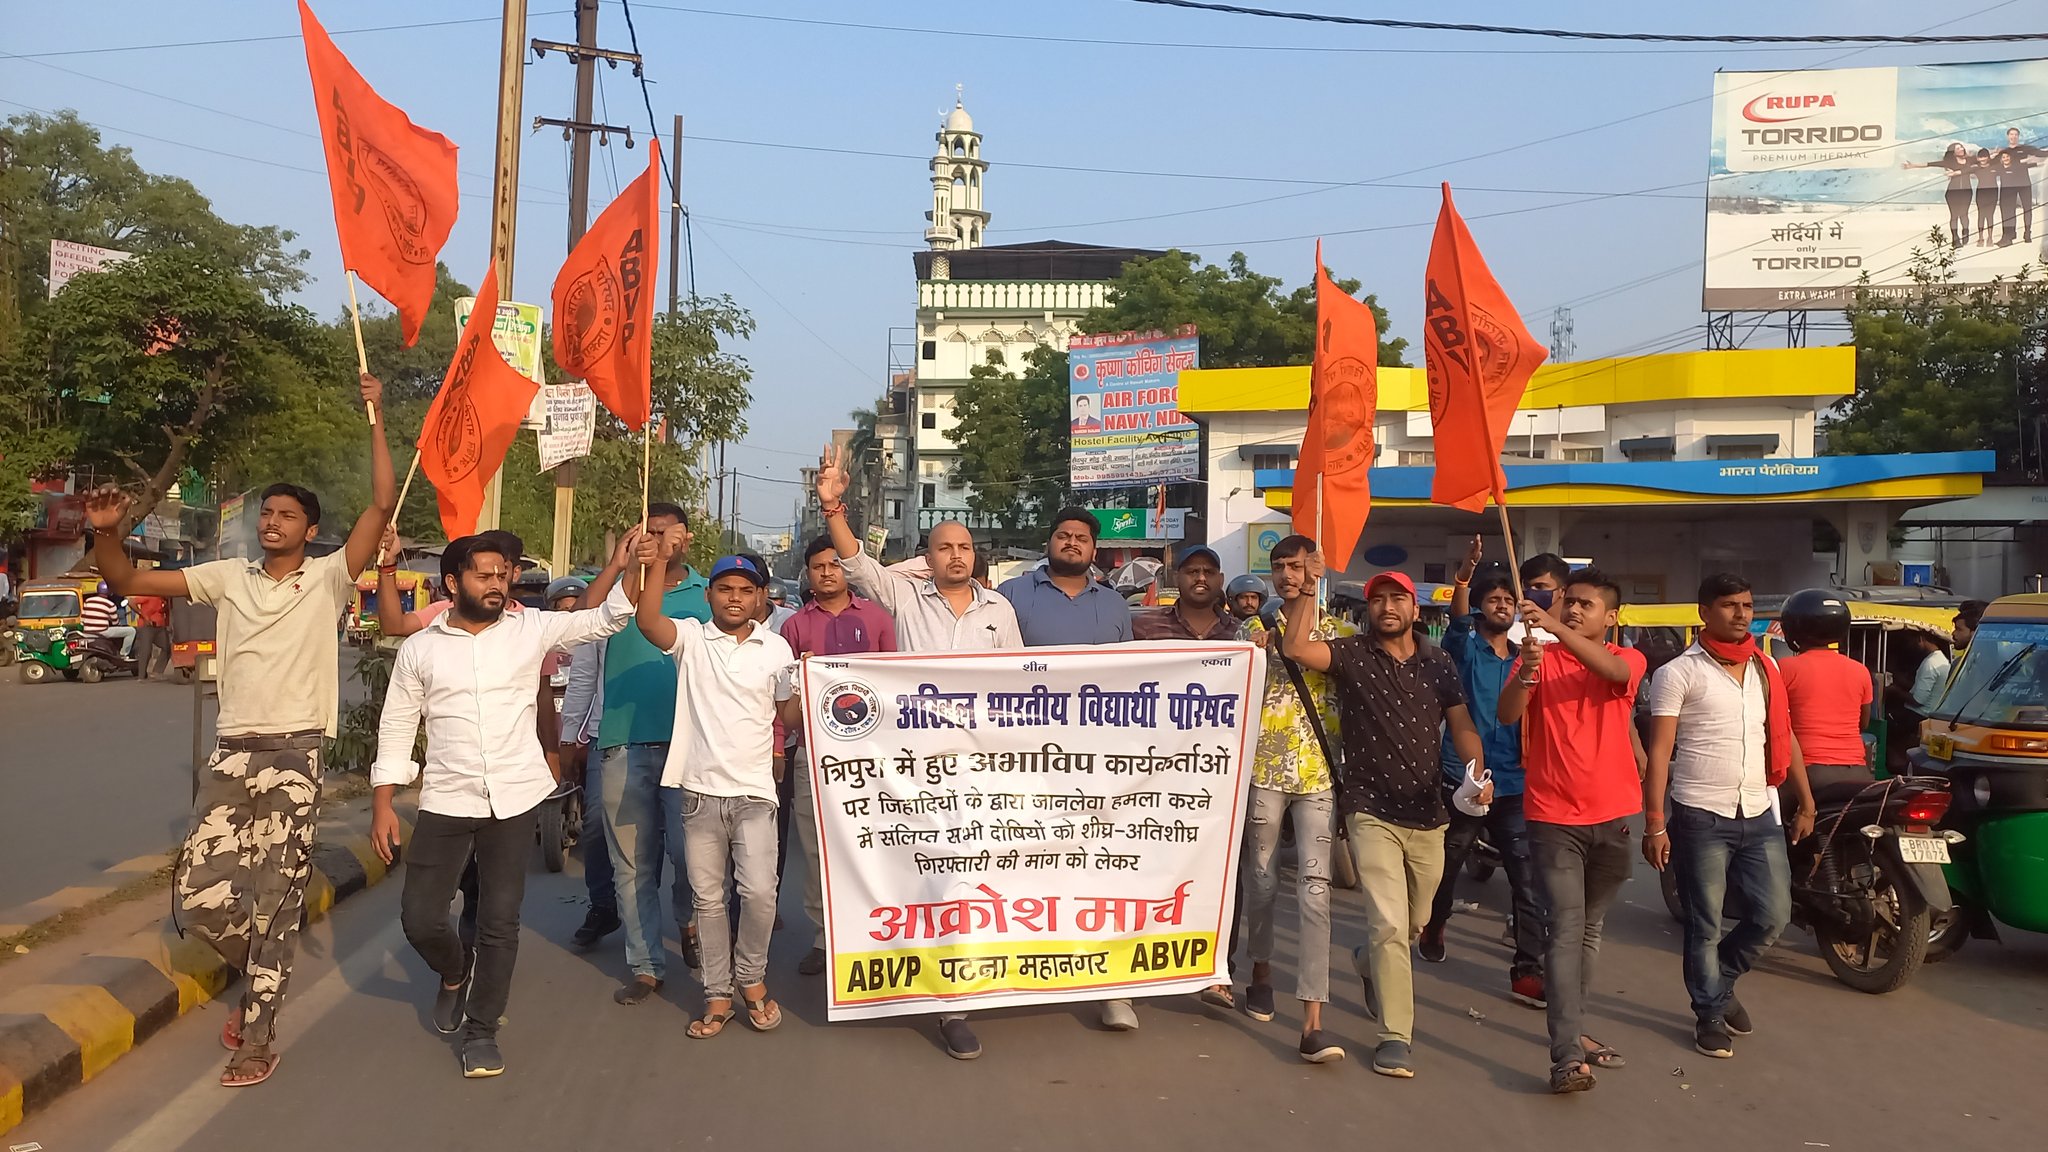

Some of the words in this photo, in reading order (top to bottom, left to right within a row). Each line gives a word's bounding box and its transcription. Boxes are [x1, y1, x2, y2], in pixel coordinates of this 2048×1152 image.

[1767, 95, 1836, 109] RUPA
[1741, 125, 1882, 145] TORRIDO
[1753, 153, 1807, 162] PREMIUM
[1813, 151, 1869, 160] THERMAL
[1771, 222, 1823, 242] सर्दियों
[1829, 221, 1844, 240] में
[55, 250, 94, 264] OFFERS
[56, 240, 106, 256] EXCITING
[1797, 245, 1817, 253] only
[1752, 256, 1862, 270] TORRIDO
[620, 229, 643, 356] ABVP
[1778, 290, 1807, 300] EXTRA
[1810, 289, 1836, 299] WARM
[1851, 288, 1913, 299] SETCHABLE
[1426, 278, 1470, 384] ABV
[1096, 360, 1123, 387] कृष्णा
[1127, 348, 1163, 376] कोचिंग
[1103, 392, 1132, 408] AIR
[1137, 386, 1178, 406] FORC
[1104, 412, 1152, 430] NAVY,
[1074, 435, 1104, 446] Hostel
[1107, 433, 1142, 446] Facility
[1720, 466, 1756, 477] भारत
[1022, 661, 1048, 672] शील
[1201, 657, 1232, 667] एकता
[896, 683, 977, 730] अखिल
[987, 684, 1071, 728] भारतीय
[1078, 682, 1160, 729] विद्यार्थी
[1168, 683, 1239, 730] परिषद
[821, 755, 885, 788] त्रिपुरा
[894, 748, 916, 777] में
[924, 753, 958, 785] हुए
[969, 743, 1096, 774] अभाविप
[1104, 744, 1231, 775] कार्यकर्ताओं
[843, 797, 870, 818] पर
[878, 788, 957, 816] जिहादियों
[965, 786, 983, 810] के
[988, 793, 1025, 811] द्वारा
[1032, 788, 1105, 811] जानलेवा
[1111, 792, 1161, 810] हमला
[1168, 788, 1212, 810] करने
[857, 826, 873, 849] में
[879, 823, 939, 847] संलिप्त
[946, 820, 984, 843] सभी
[990, 818, 1045, 842] दोषियों
[1051, 818, 1075, 840] को
[914, 850, 991, 875] गिरफ्तारी
[996, 850, 1019, 870] की
[1025, 849, 1061, 869] मांग
[1066, 846, 1088, 869] को
[1094, 846, 1141, 871] लेकर
[869, 883, 1061, 942] आक्रोश
[1074, 880, 1194, 933] मार्च
[847, 955, 921, 992] ABVP
[939, 956, 1008, 983] पटना
[1017, 951, 1109, 980] महानगर
[1130, 938, 1208, 973] ABVP
